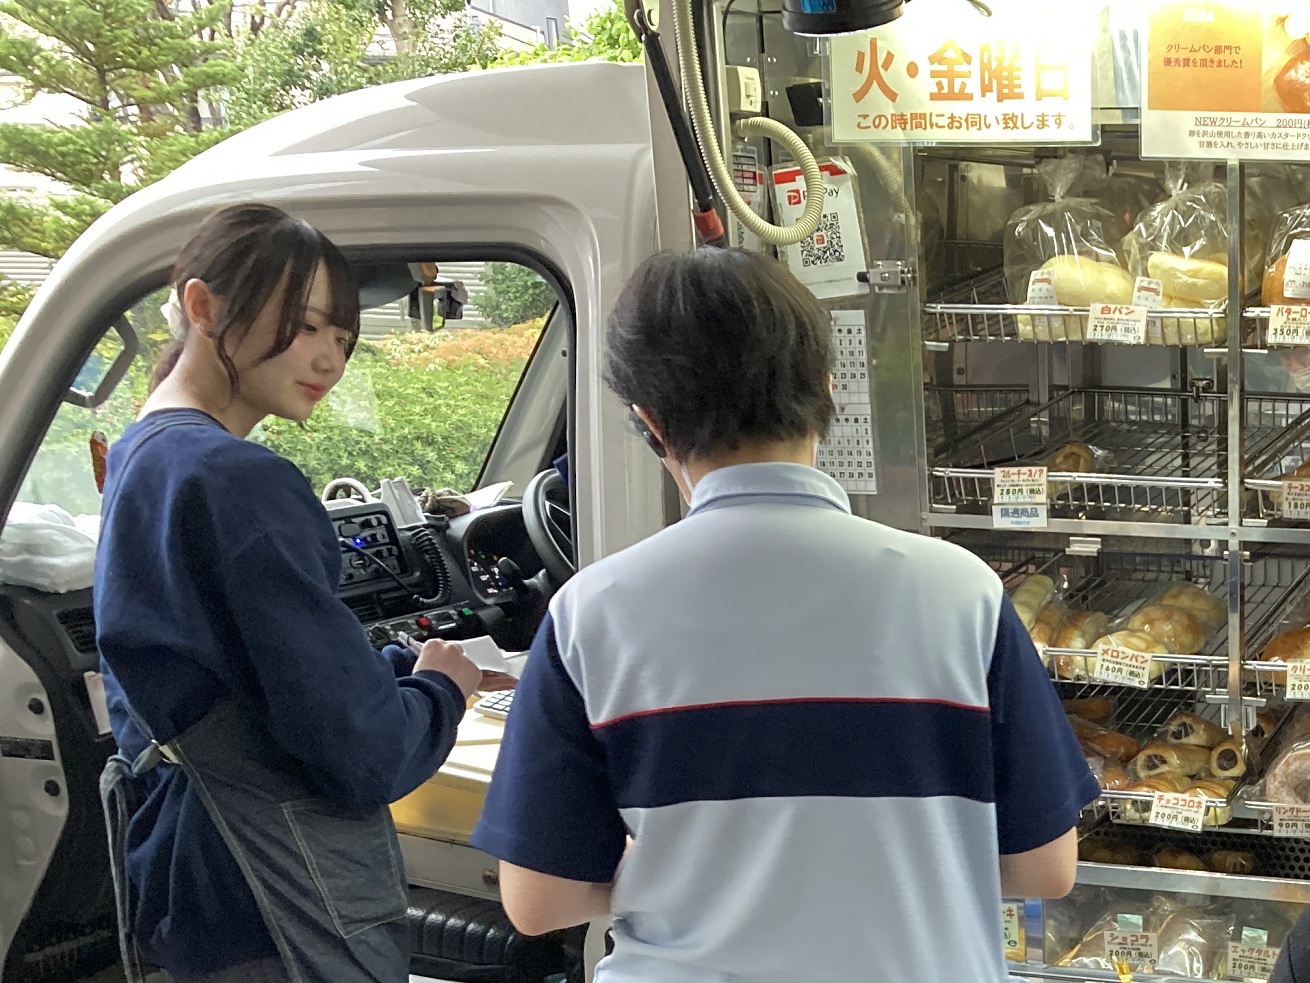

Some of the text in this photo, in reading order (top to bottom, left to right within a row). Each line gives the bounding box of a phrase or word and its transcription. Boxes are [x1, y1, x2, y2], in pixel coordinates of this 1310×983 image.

[1166, 44, 1241, 55] クリームパン部門で
[852, 37, 1070, 103] 火・金曜日
[1163, 56, 1243, 69] 優秀賞を頂きました!
[856, 112, 1075, 131] この時間にお伺い致します。
[1195, 117, 1266, 127] NEWクリームパン
[802, 187, 840, 202] PPay
[1101, 305, 1134, 315] 白パン
[1101, 648, 1149, 665] メロンパン
[1157, 794, 1203, 810] チョココロネ
[1109, 932, 1150, 944] ショコラ
[1231, 945, 1278, 960] エッグタルト
